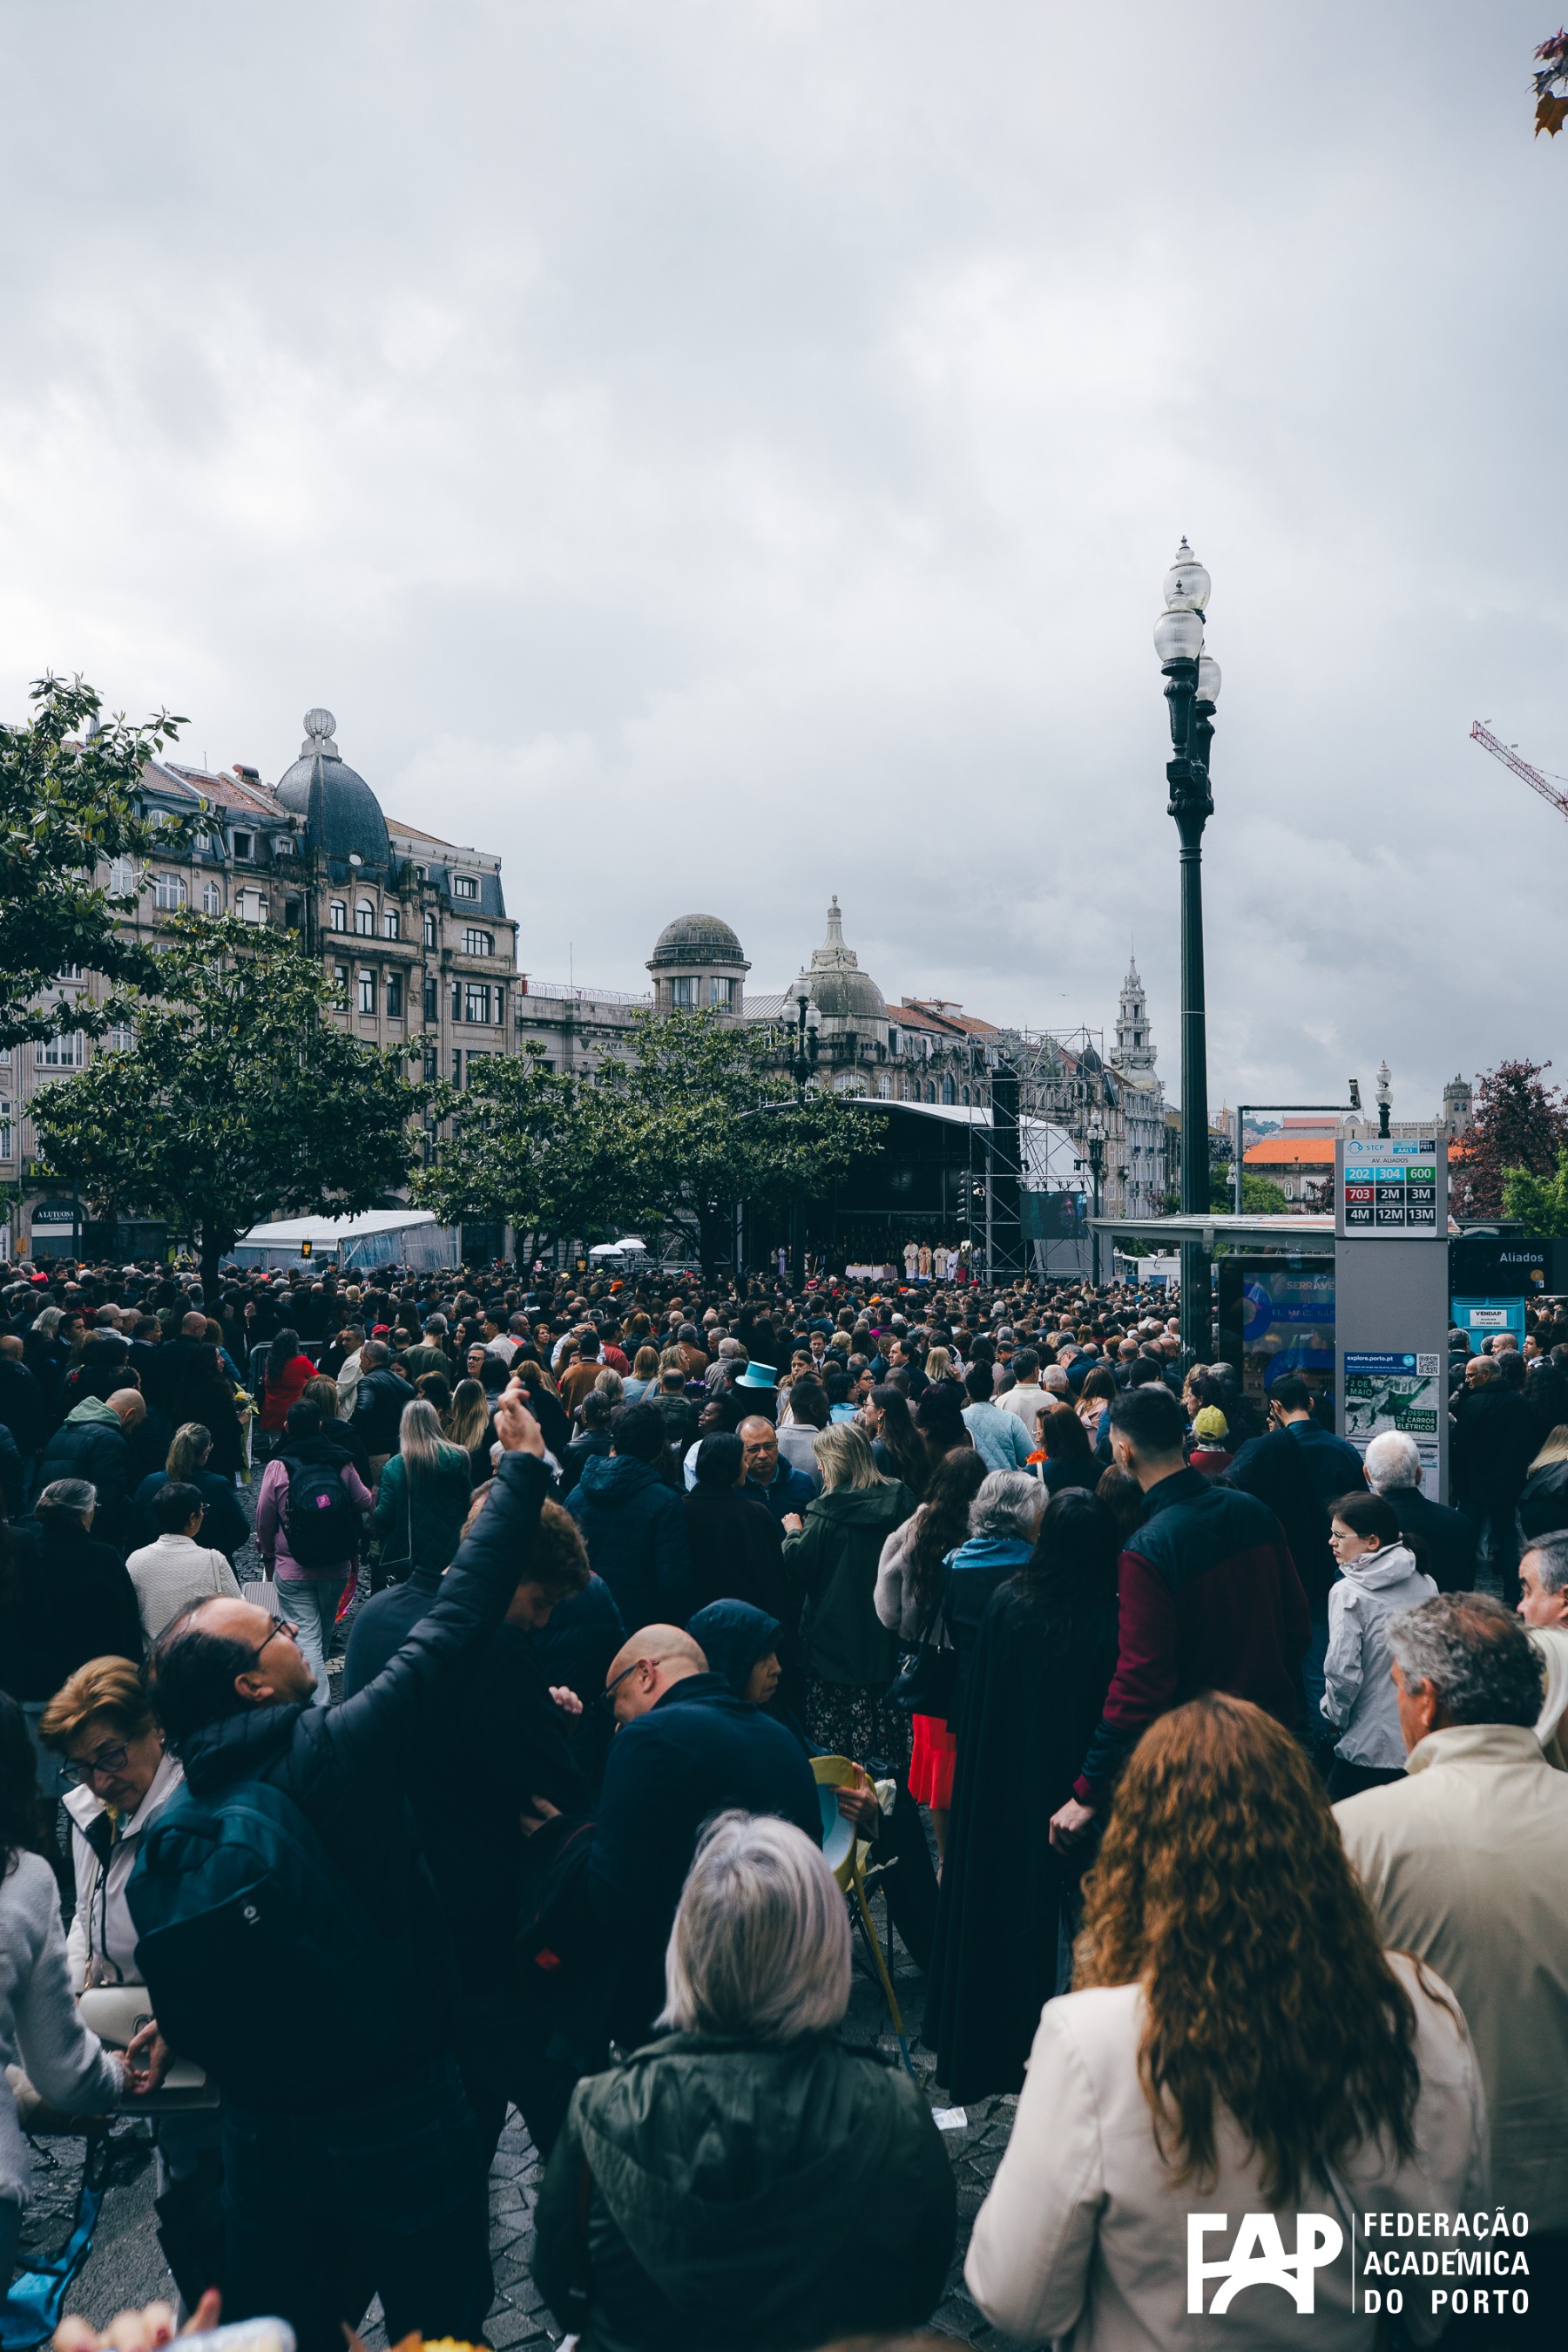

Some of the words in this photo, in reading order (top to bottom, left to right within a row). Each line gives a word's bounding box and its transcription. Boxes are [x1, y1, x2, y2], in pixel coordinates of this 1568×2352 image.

[1349, 1169, 1370, 1179] 202
[1379, 1169, 1400, 1178] 304
[1411, 1169, 1431, 1178] 600
[1350, 1189, 1370, 1199] 703
[1381, 1189, 1399, 1199] 2M
[1412, 1189, 1430, 1198] 3M
[1351, 1210, 1369, 1219] 4M
[1378, 1210, 1403, 1219] 12M
[1409, 1210, 1433, 1219] 13M
[1500, 1253, 1544, 1262] Aliados
